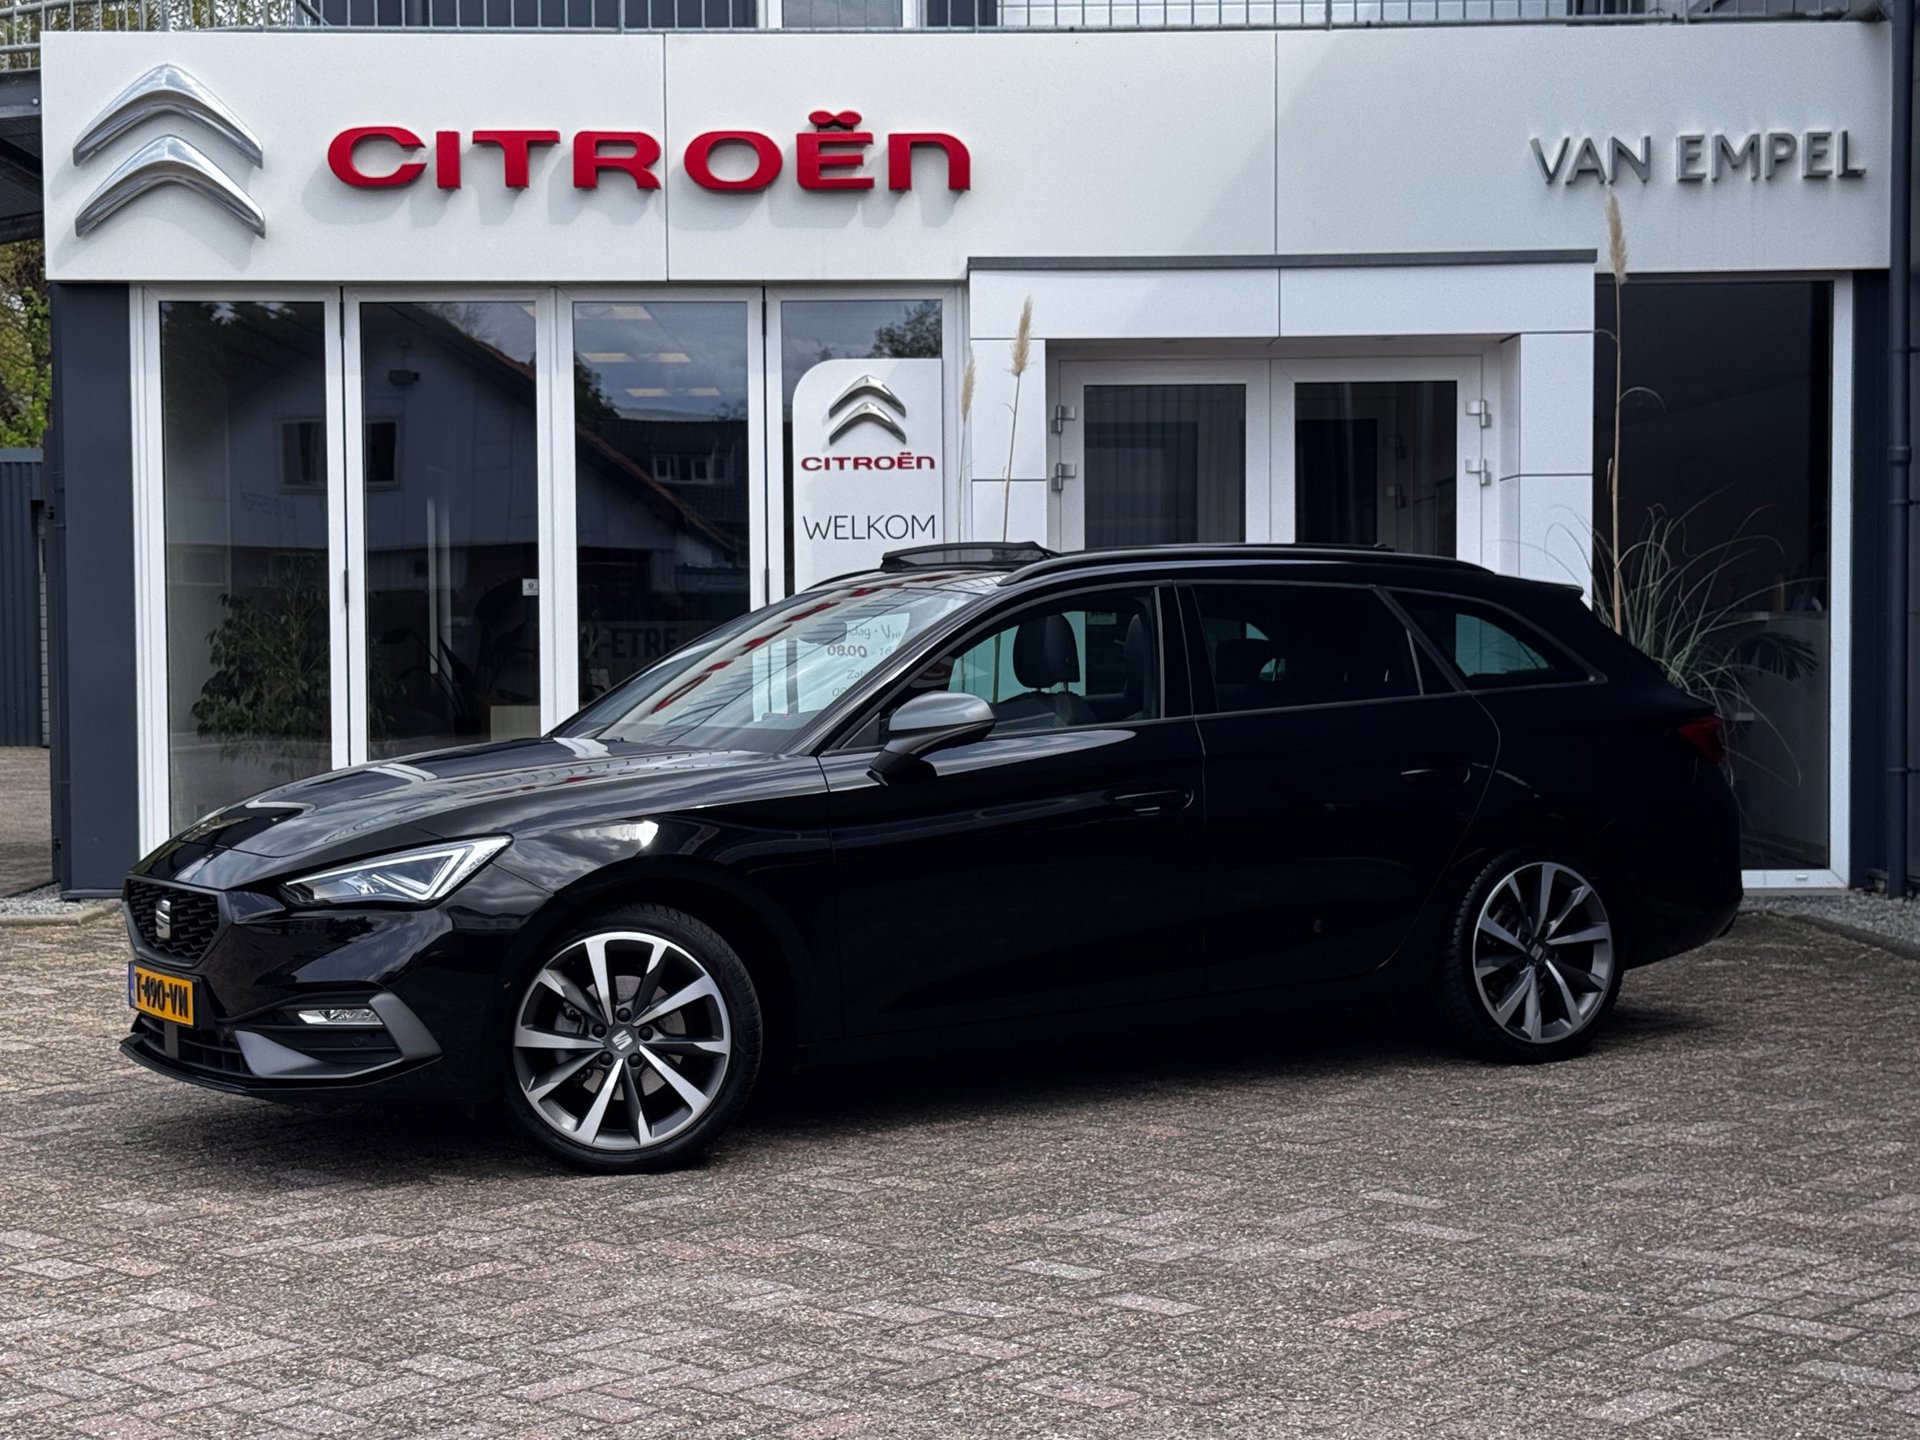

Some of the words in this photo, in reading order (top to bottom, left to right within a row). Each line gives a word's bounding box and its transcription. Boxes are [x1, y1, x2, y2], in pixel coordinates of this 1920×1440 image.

[1529, 135, 1651, 186] VAN
[1675, 129, 1867, 183] EMPEL
[802, 514, 936, 541] WELKOM
[827, 644, 868, 659] 08.00
[135, 972, 189, 1018] T-490-VN
